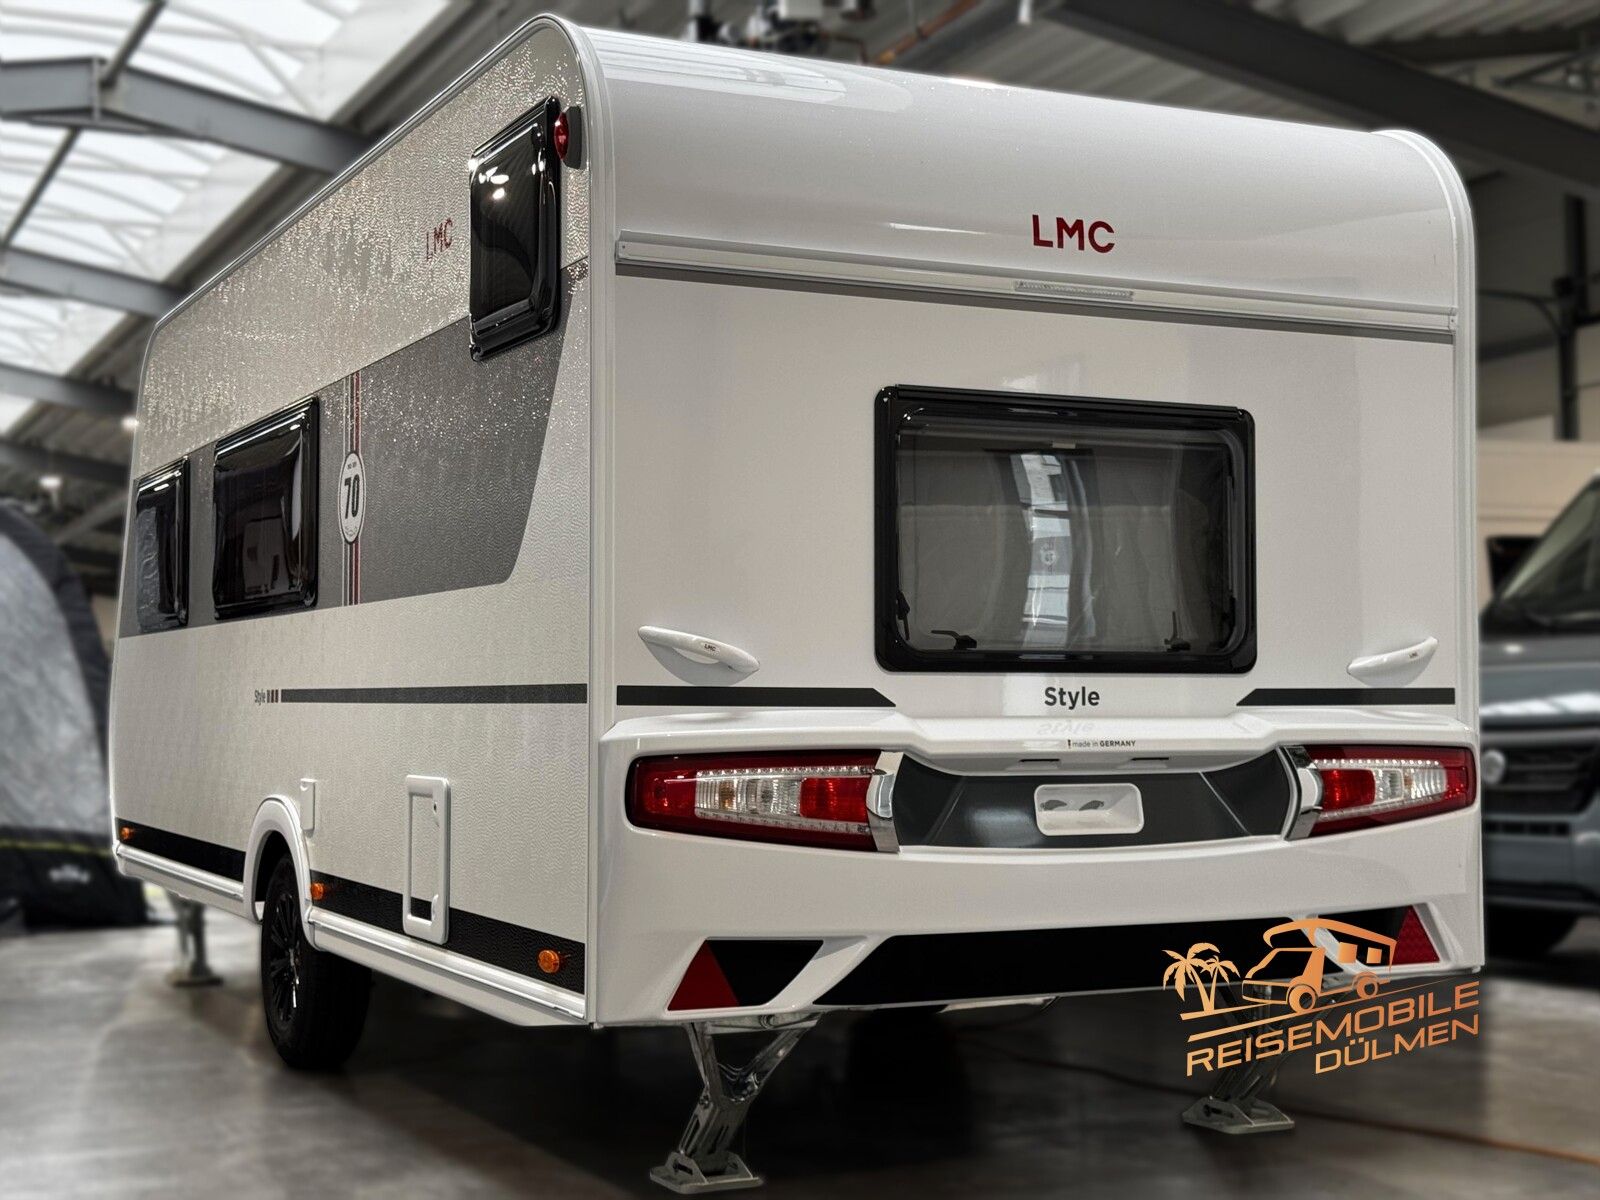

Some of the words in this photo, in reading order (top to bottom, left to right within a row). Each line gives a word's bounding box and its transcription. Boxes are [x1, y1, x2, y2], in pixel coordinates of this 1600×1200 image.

[426, 217, 453, 261] LMC
[1032, 214, 1115, 253] LMC
[344, 473, 360, 519] 70
[1044, 686, 1100, 710] Style
[1072, 740, 1091, 748] made
[1092, 740, 1099, 748] in
[1100, 740, 1136, 748] GERMANY
